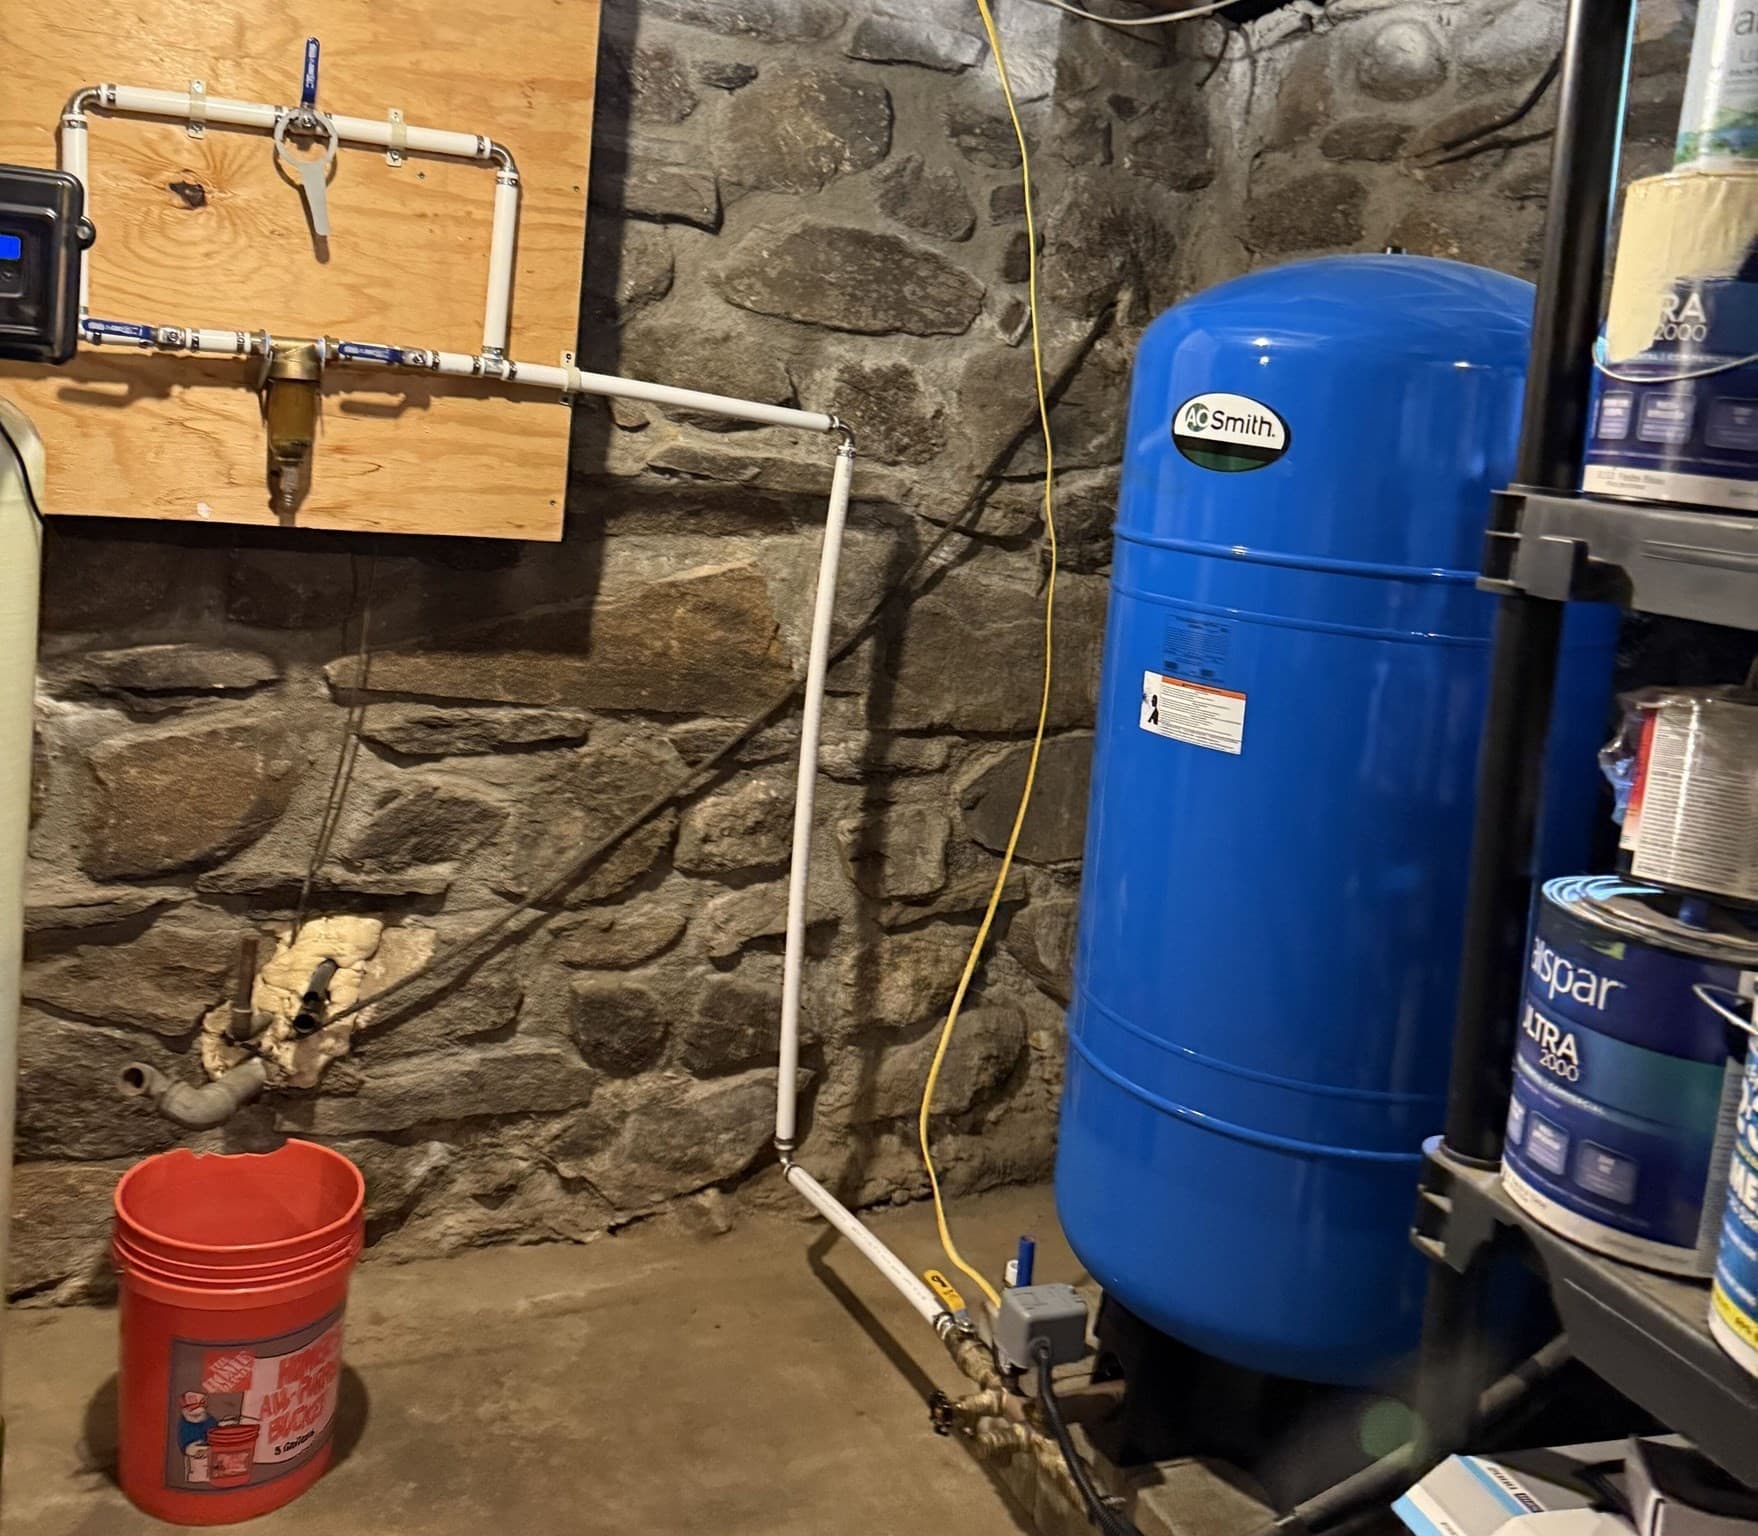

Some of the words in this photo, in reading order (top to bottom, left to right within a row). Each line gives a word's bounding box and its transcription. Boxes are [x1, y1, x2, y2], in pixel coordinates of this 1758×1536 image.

[1661, 293, 1707, 322] RA
[1653, 323, 1707, 342] 2000
[1539, 1049, 1580, 1082] 2000
[274, 1446, 282, 1456] 5
